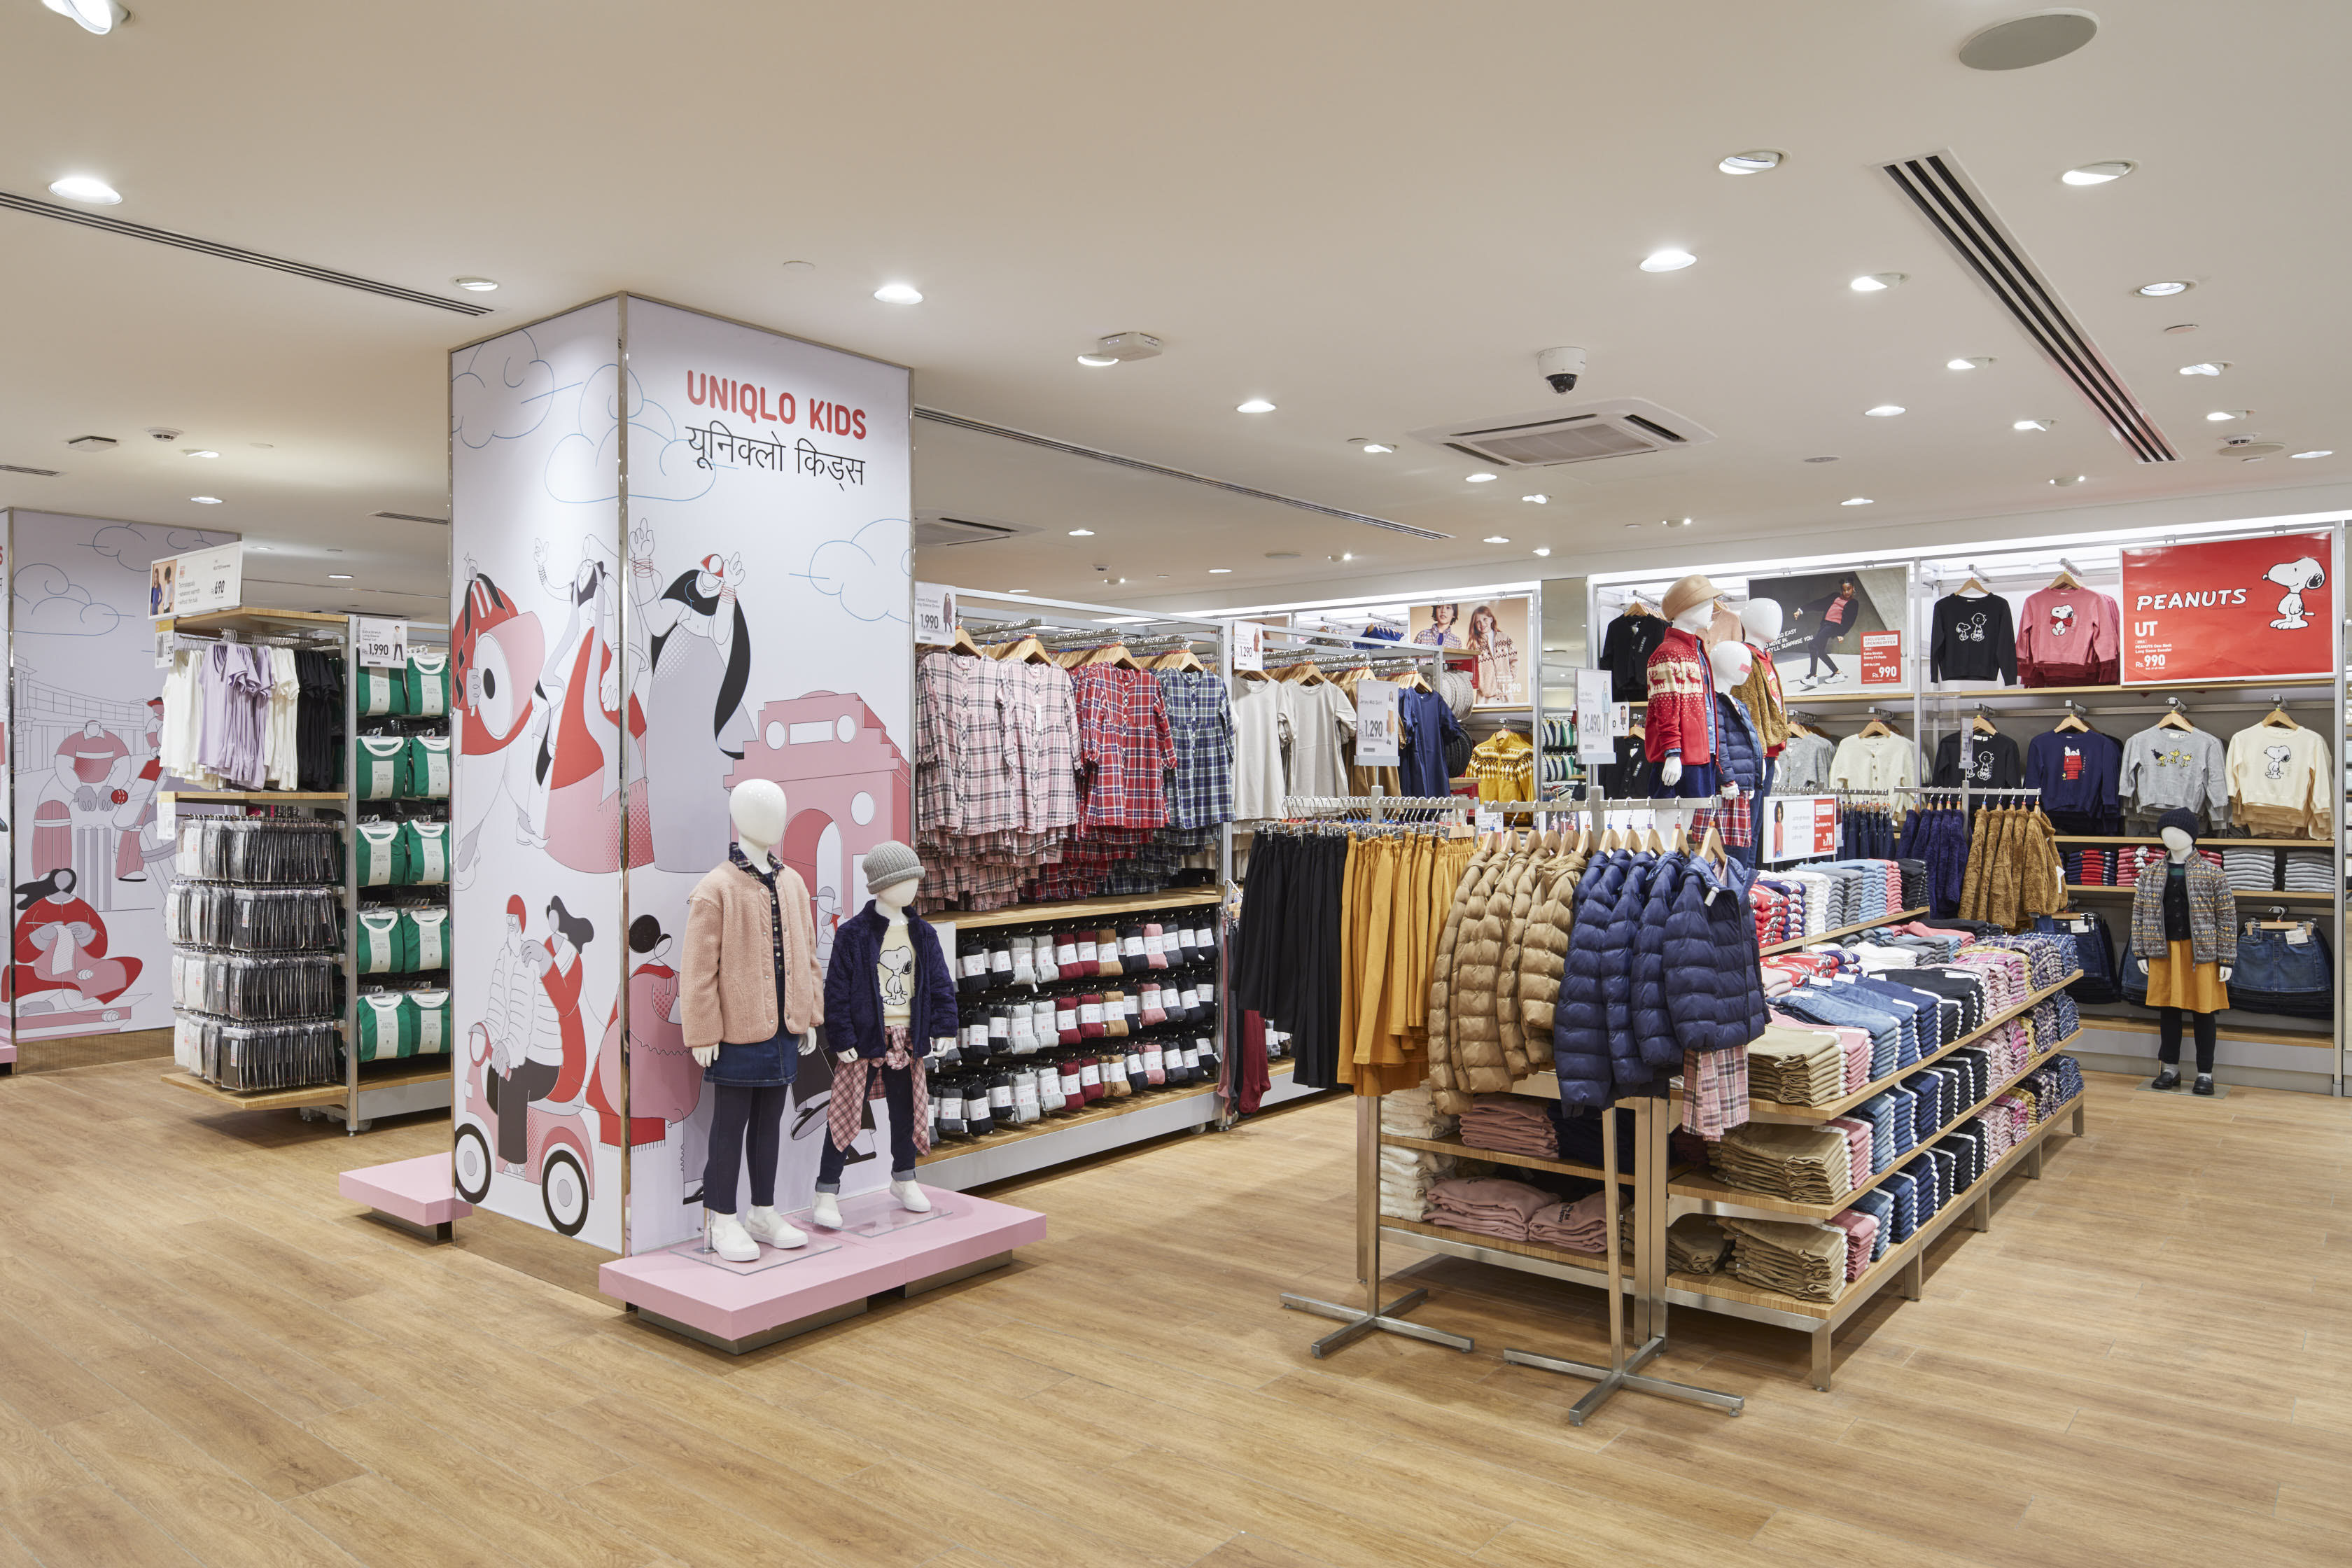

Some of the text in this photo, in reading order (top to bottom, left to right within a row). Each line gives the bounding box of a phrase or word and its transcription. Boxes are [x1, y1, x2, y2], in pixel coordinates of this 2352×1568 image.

[687, 370, 867, 440] UNIQLO KIDS
[685, 420, 866, 492] यूनिक्लो किड्स
[214, 580, 225, 594] 690
[2136, 588, 2247, 611] PEANUTS
[920, 613, 939, 629] 1,990
[2135, 621, 2158, 637] UT
[369, 643, 388, 655] 1,990
[1782, 638, 1802, 649] SURPRISE
[2144, 654, 2165, 667] 990
[1879, 666, 1896, 678] 990
[1503, 682, 1521, 693] 1,290
[1365, 720, 1382, 738] 1,290
[1584, 713, 1601, 734] 2,490
